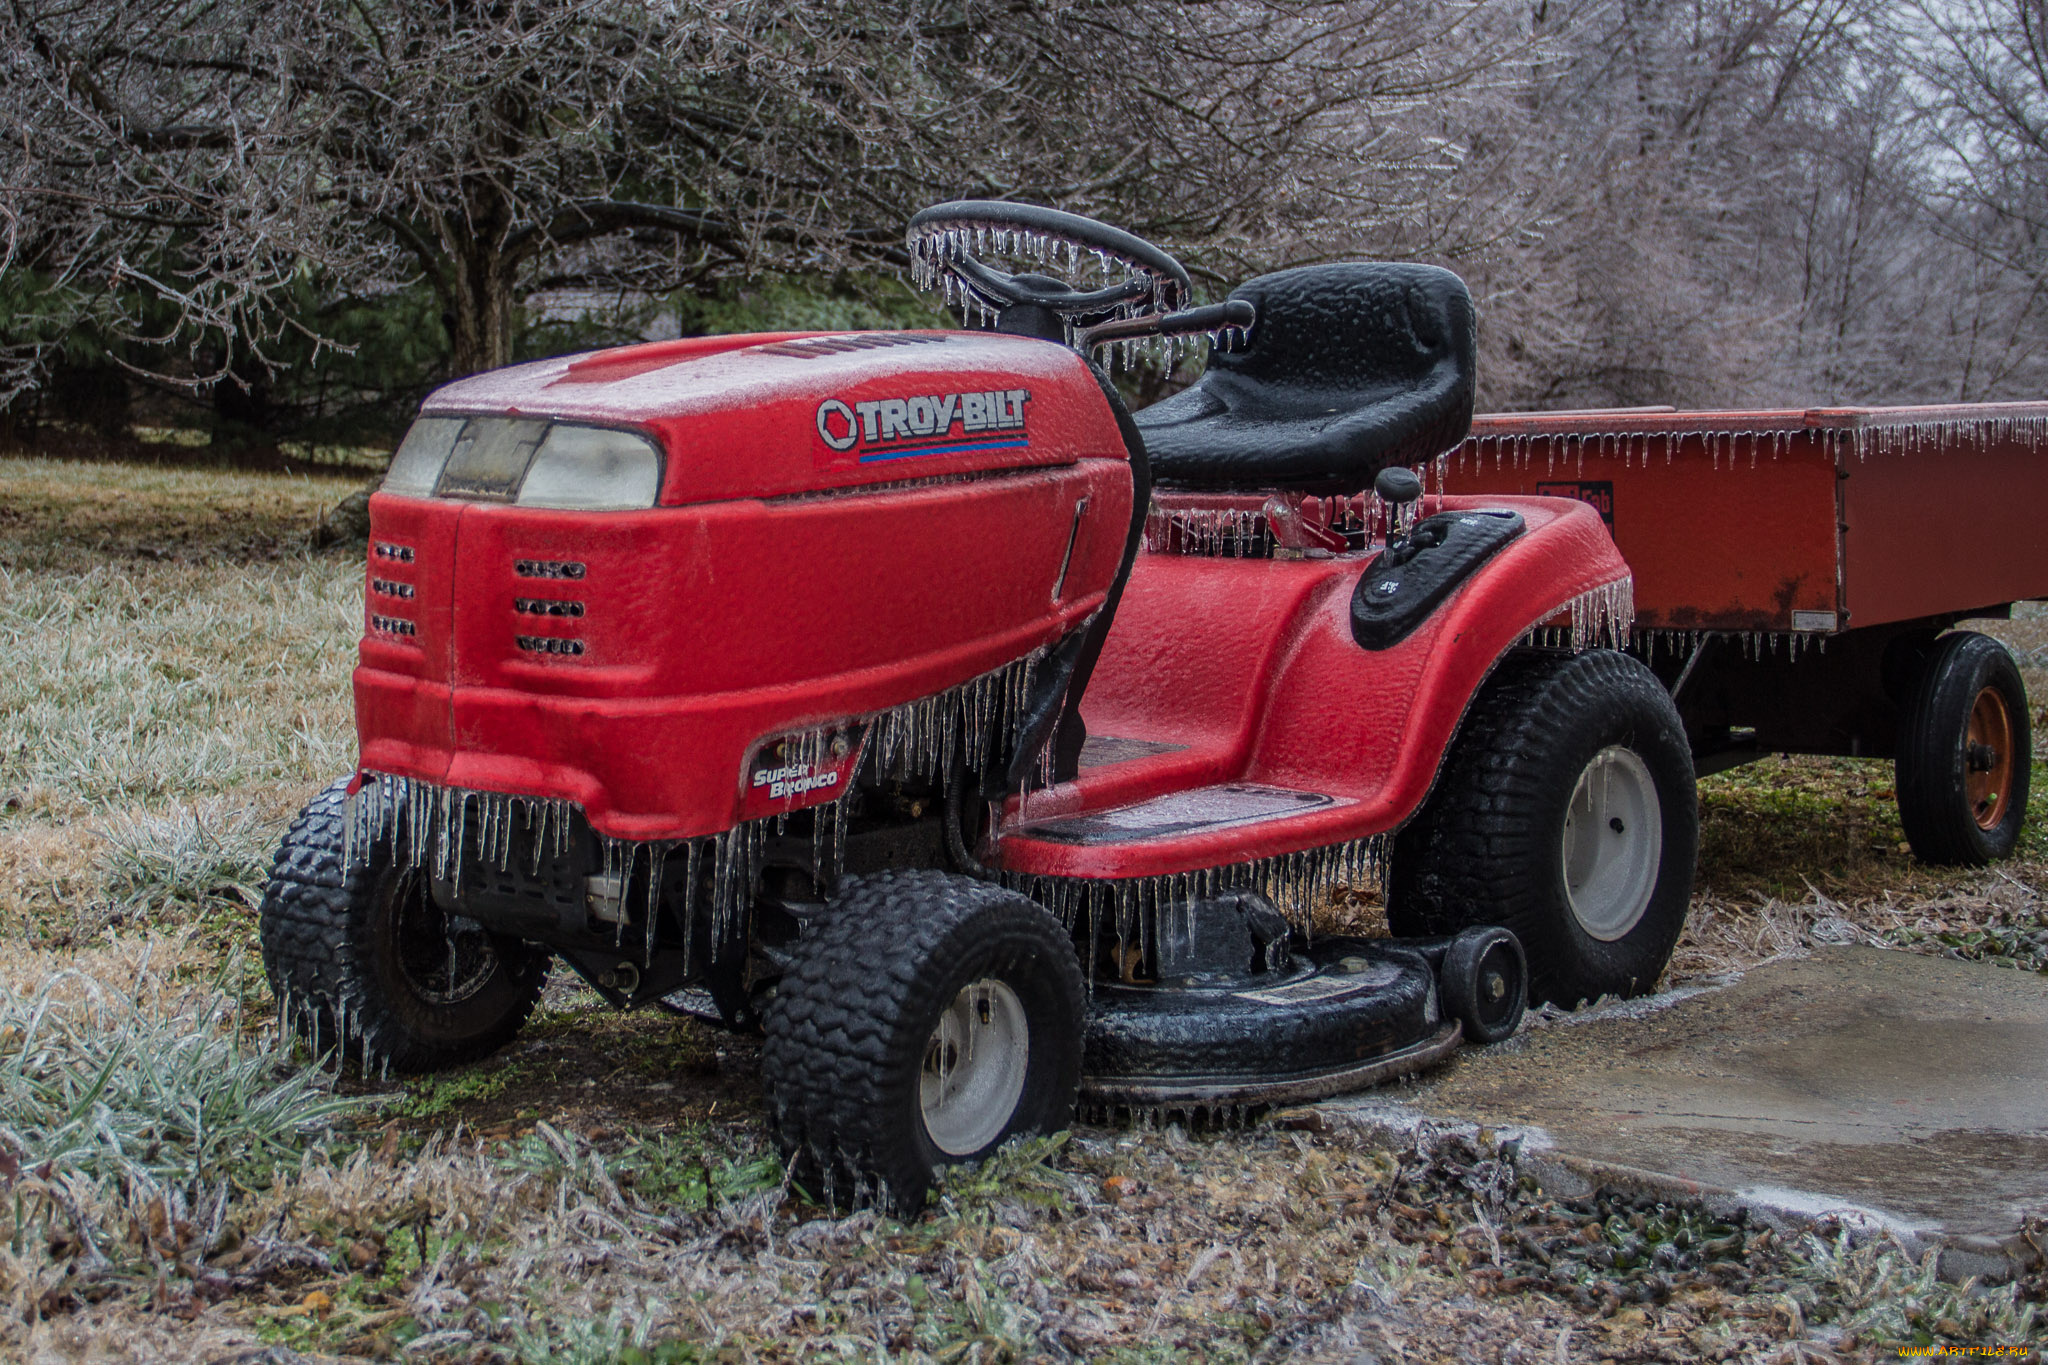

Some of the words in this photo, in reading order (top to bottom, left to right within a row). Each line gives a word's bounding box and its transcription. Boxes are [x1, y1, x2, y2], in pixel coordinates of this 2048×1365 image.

[855, 390, 1031, 443] TROY-BILT
[753, 763, 810, 787] SUPER
[769, 771, 838, 799] BRONCO
